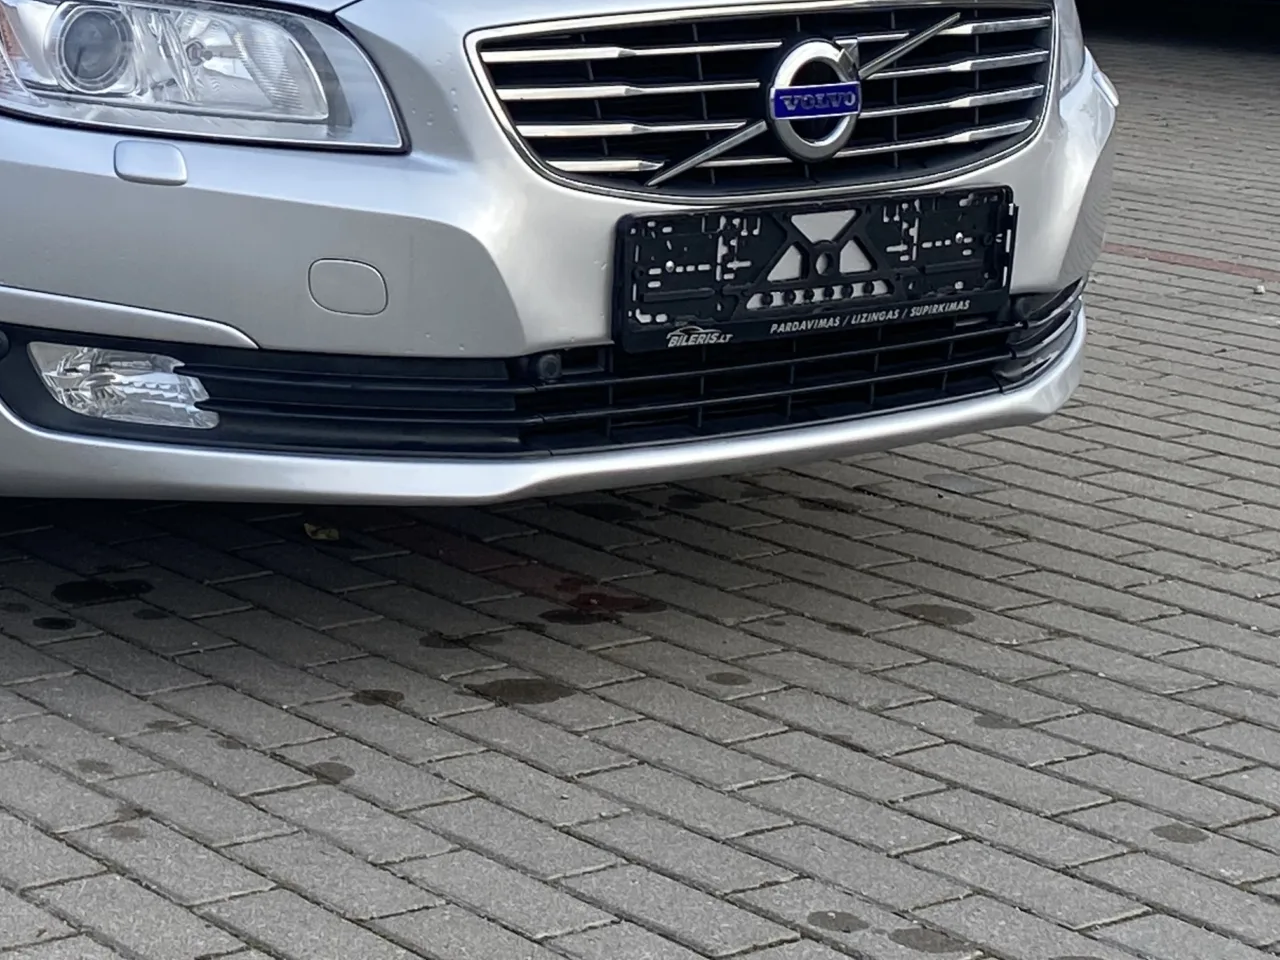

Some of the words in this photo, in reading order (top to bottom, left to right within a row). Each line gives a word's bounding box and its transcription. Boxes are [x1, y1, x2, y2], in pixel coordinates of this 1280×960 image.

[780, 91, 856, 111] VOLVO
[770, 316, 840, 334] PARDAVIMAS
[851, 309, 900, 325] LIZINGAS
[910, 300, 971, 317] SUPIRKIMAS
[667, 333, 734, 347] BILERIS.LT
